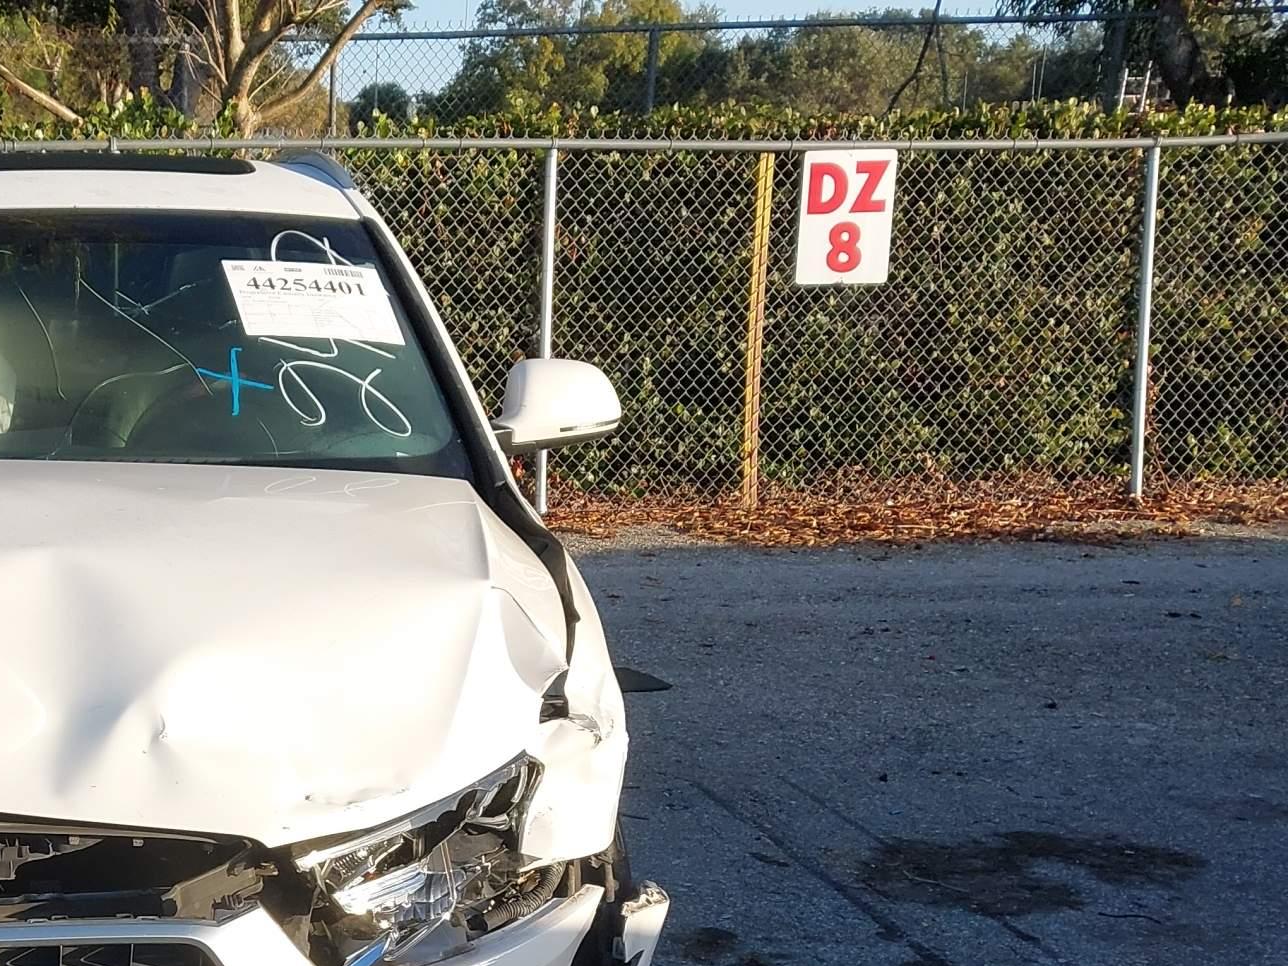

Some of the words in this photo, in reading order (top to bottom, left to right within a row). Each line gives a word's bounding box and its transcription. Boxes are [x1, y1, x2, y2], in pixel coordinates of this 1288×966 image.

[807, 160, 891, 215] DZ
[826, 221, 862, 273] 8
[246, 276, 367, 296] 44254401
